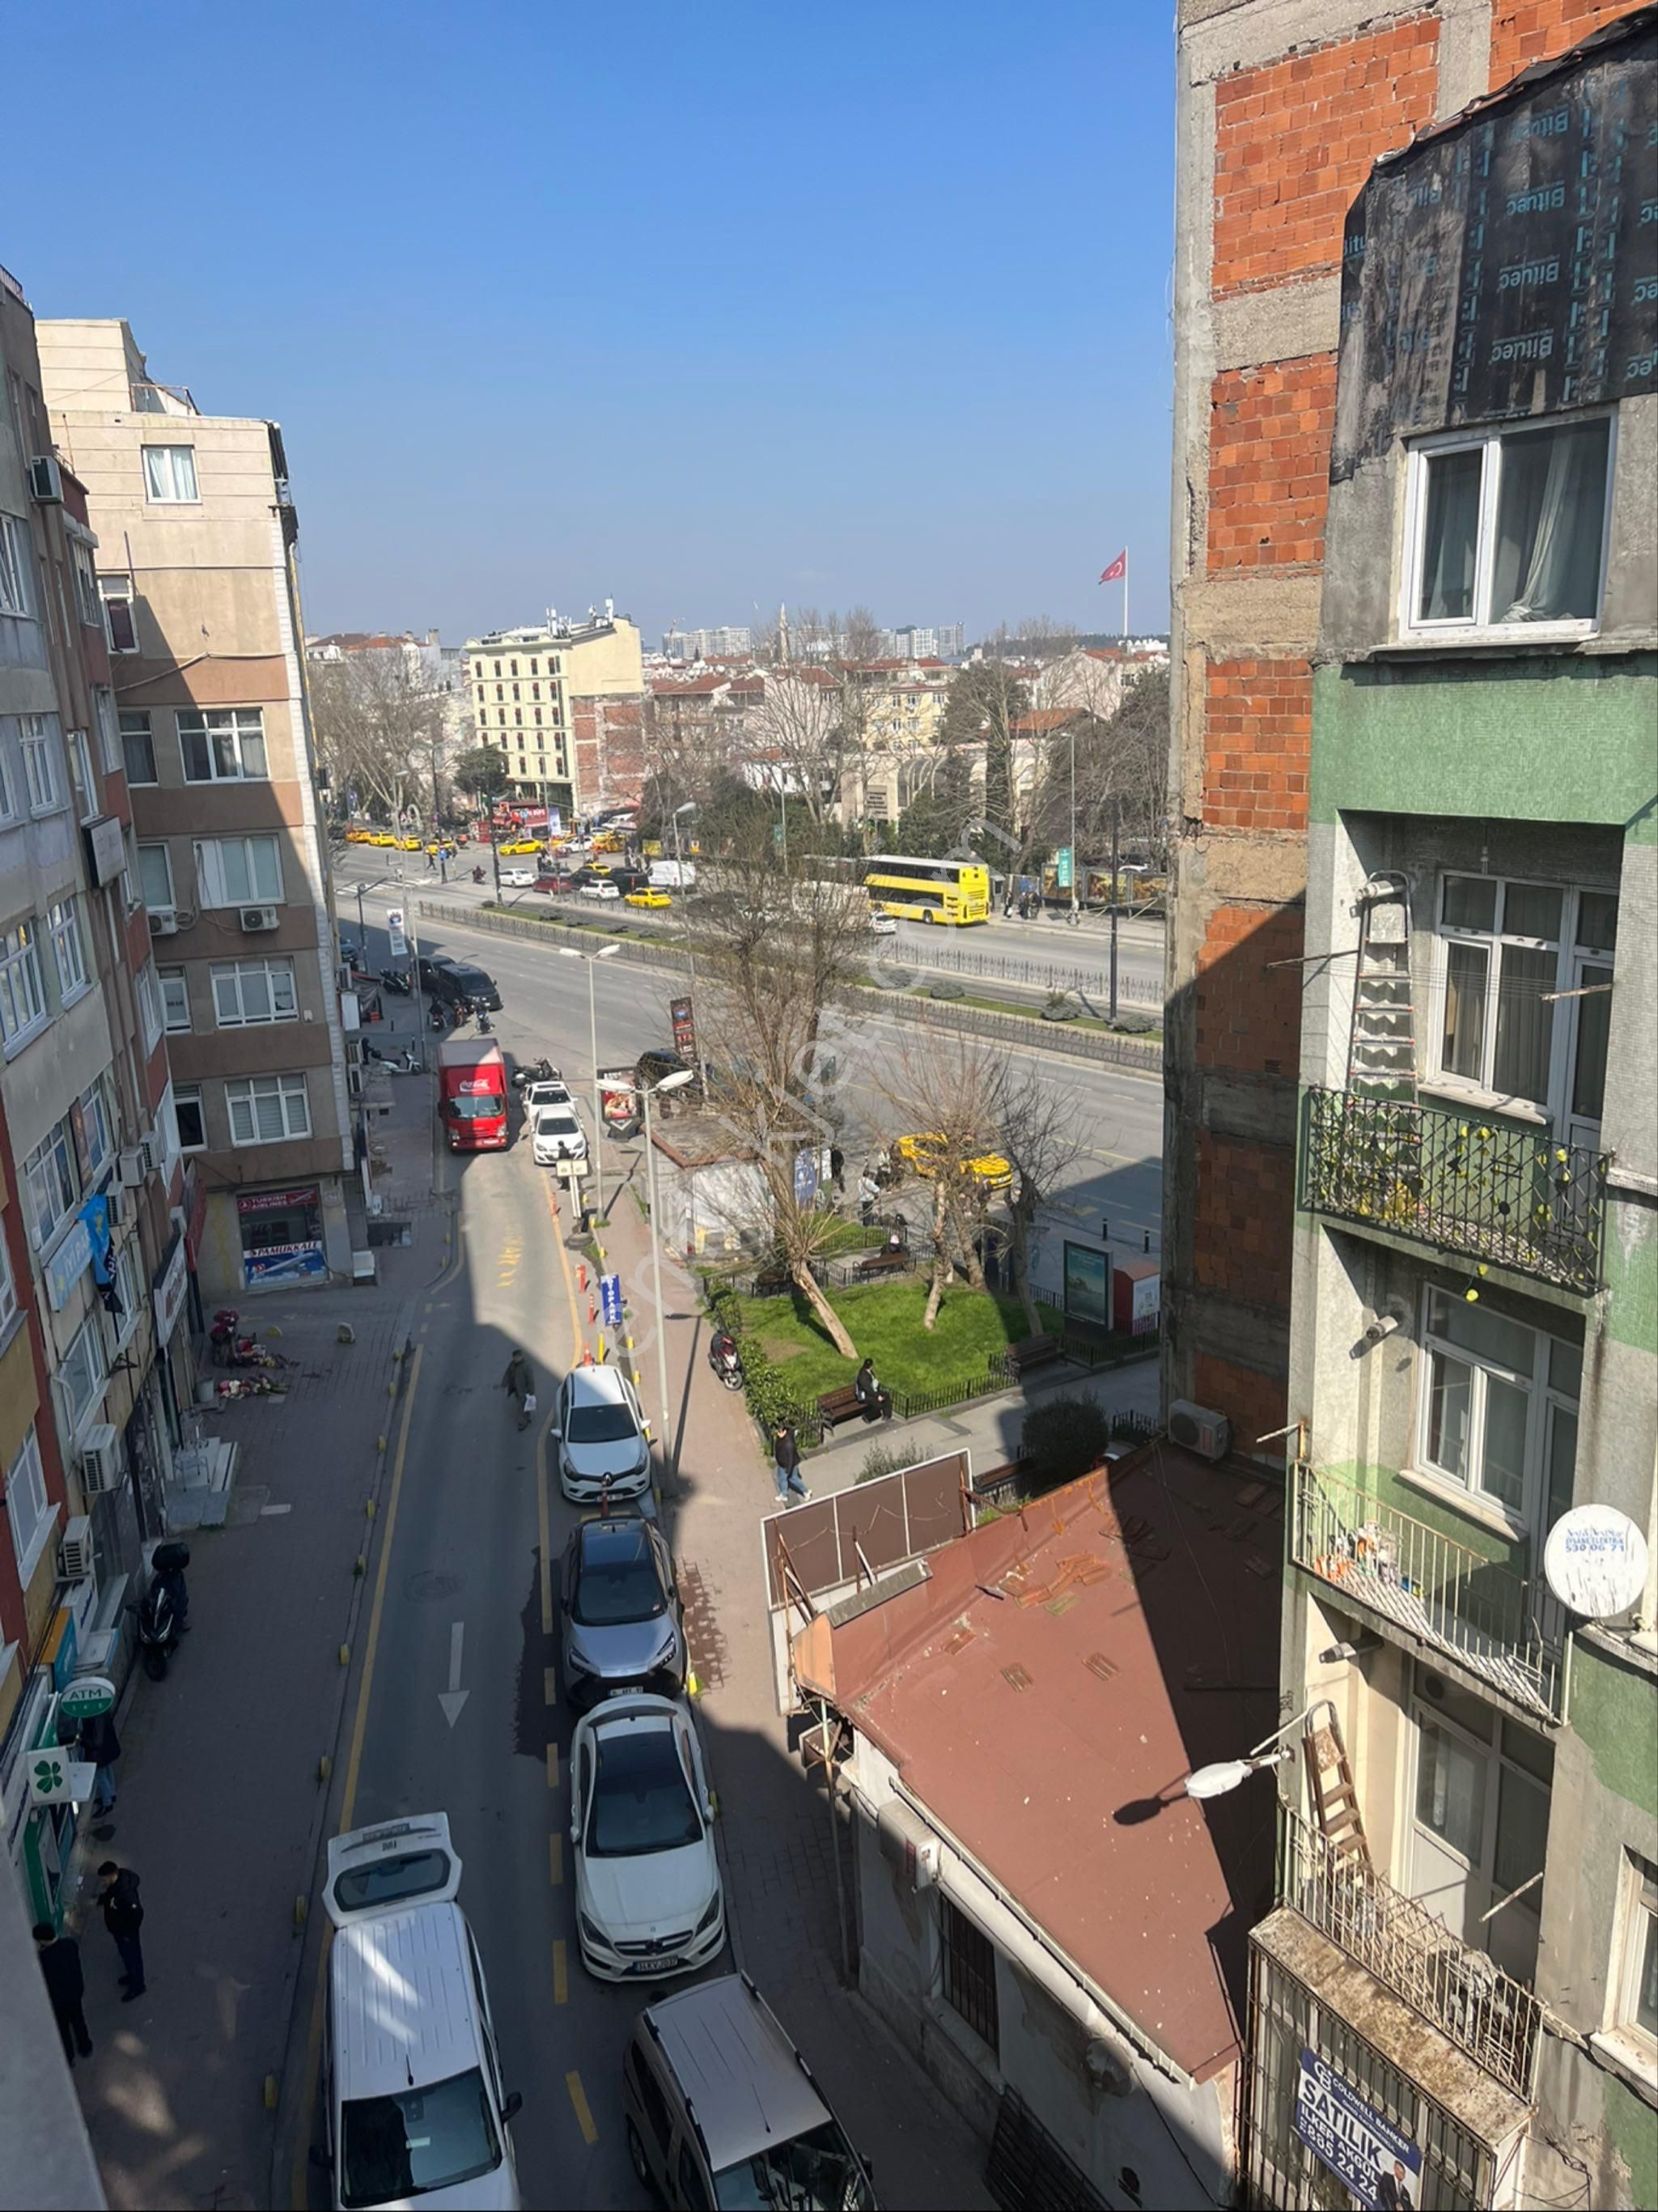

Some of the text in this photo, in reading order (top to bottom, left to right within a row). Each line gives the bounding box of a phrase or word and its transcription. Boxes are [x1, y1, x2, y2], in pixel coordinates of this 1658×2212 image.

[252, 1195, 287, 1204] TURKISH
[252, 1200, 287, 1209] AIRLINES
[70, 1688, 102, 1700] ATM
[1303, 2078, 1382, 2170] SATILIK
[1333, 2078, 1374, 2121] COLDWELL
[1376, 2117, 1410, 2154] BANKER
[1337, 2153, 1355, 2179] 24
[1359, 2175, 1377, 2201] 24
